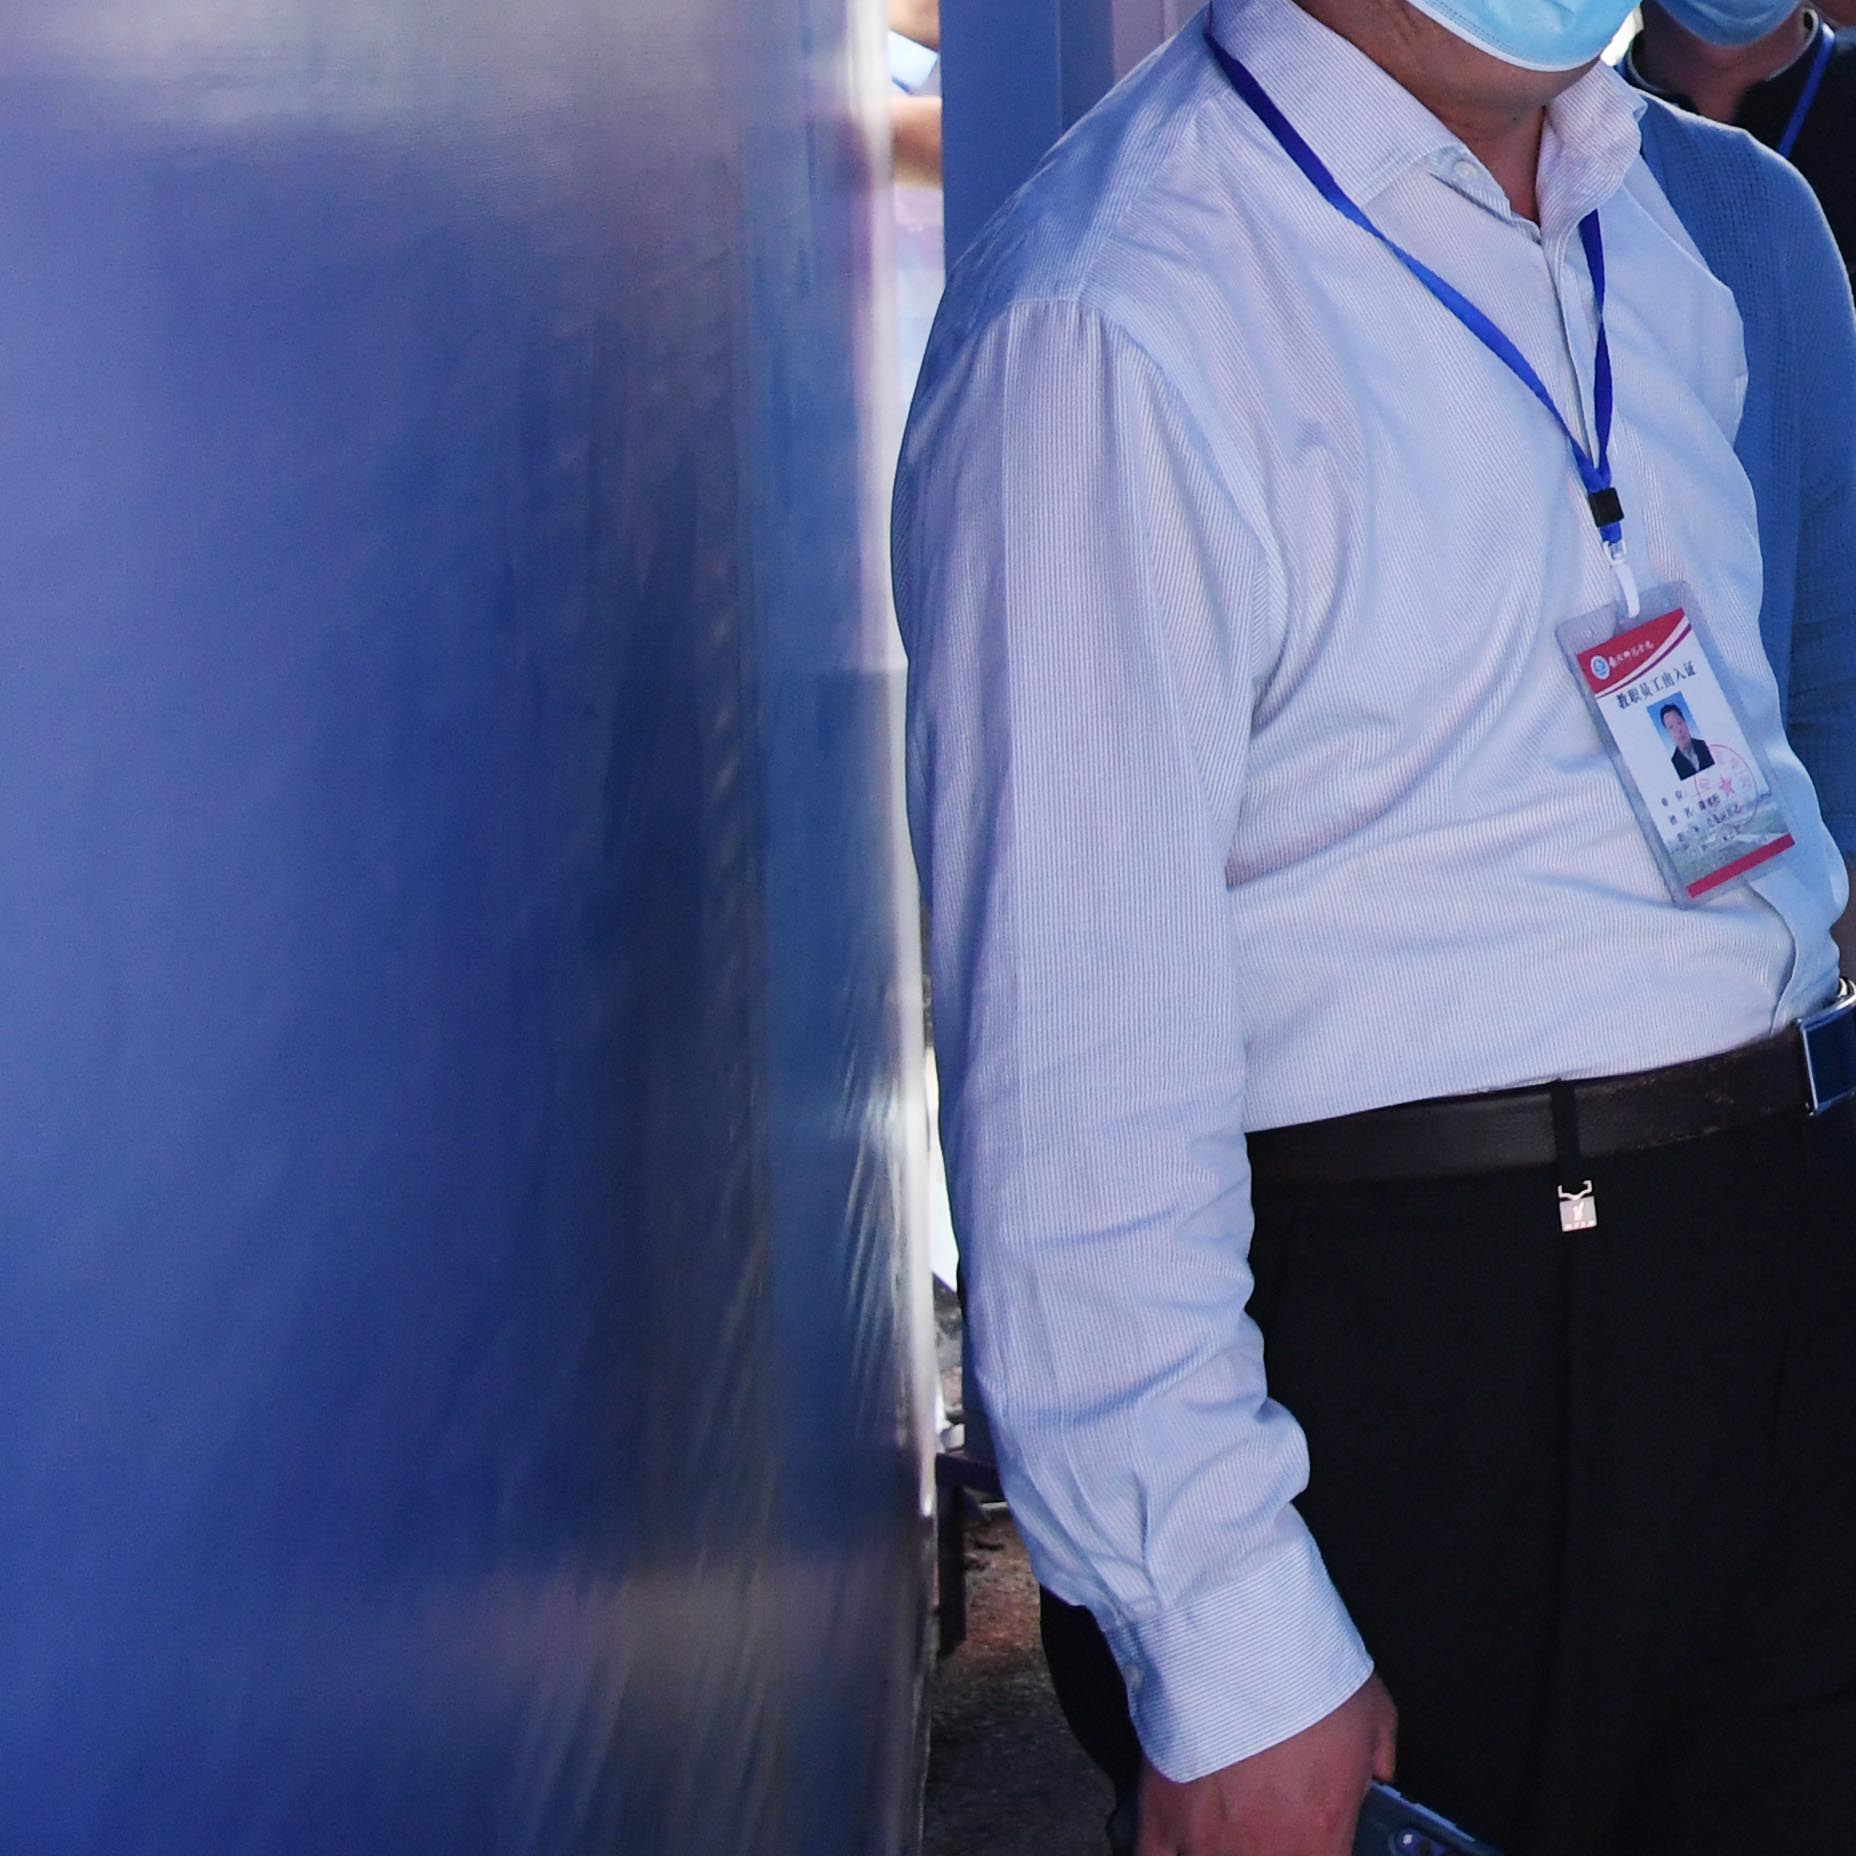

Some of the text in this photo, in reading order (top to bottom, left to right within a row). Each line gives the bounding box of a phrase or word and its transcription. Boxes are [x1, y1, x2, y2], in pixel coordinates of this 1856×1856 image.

[1615, 659, 1698, 711] 教职员工出入证
